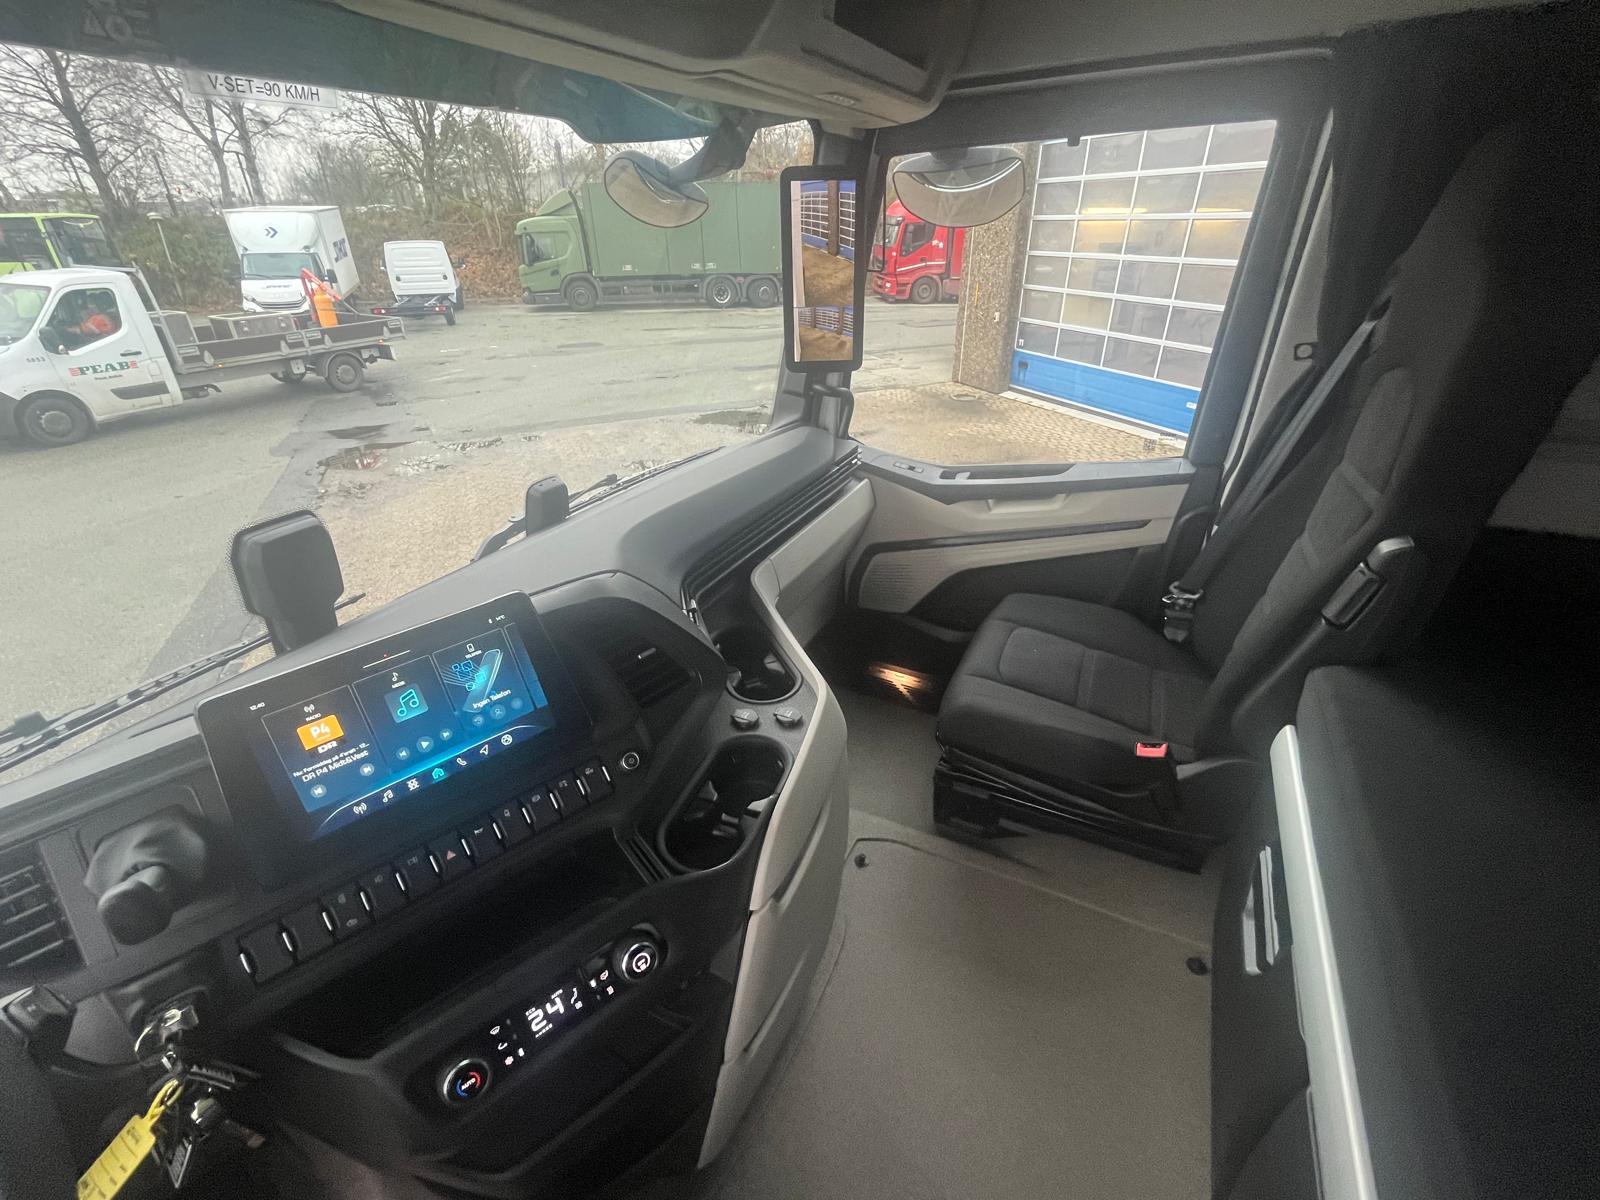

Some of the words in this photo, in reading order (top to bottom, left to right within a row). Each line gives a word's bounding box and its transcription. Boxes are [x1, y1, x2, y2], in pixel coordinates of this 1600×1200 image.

[207, 74, 281, 97] V-SET=90
[284, 84, 320, 101] KM/H
[79, 361, 131, 376] PEAB
[473, 697, 490, 709] Ingen
[490, 689, 511, 701] Telefon
[306, 713, 321, 721] RADIO
[311, 723, 330, 738] P4
[317, 741, 337, 753] DR
[302, 772, 316, 782] DR
[315, 767, 328, 776] P4
[528, 997, 564, 1032] 24
[461, 1078, 476, 1090] AUTO
